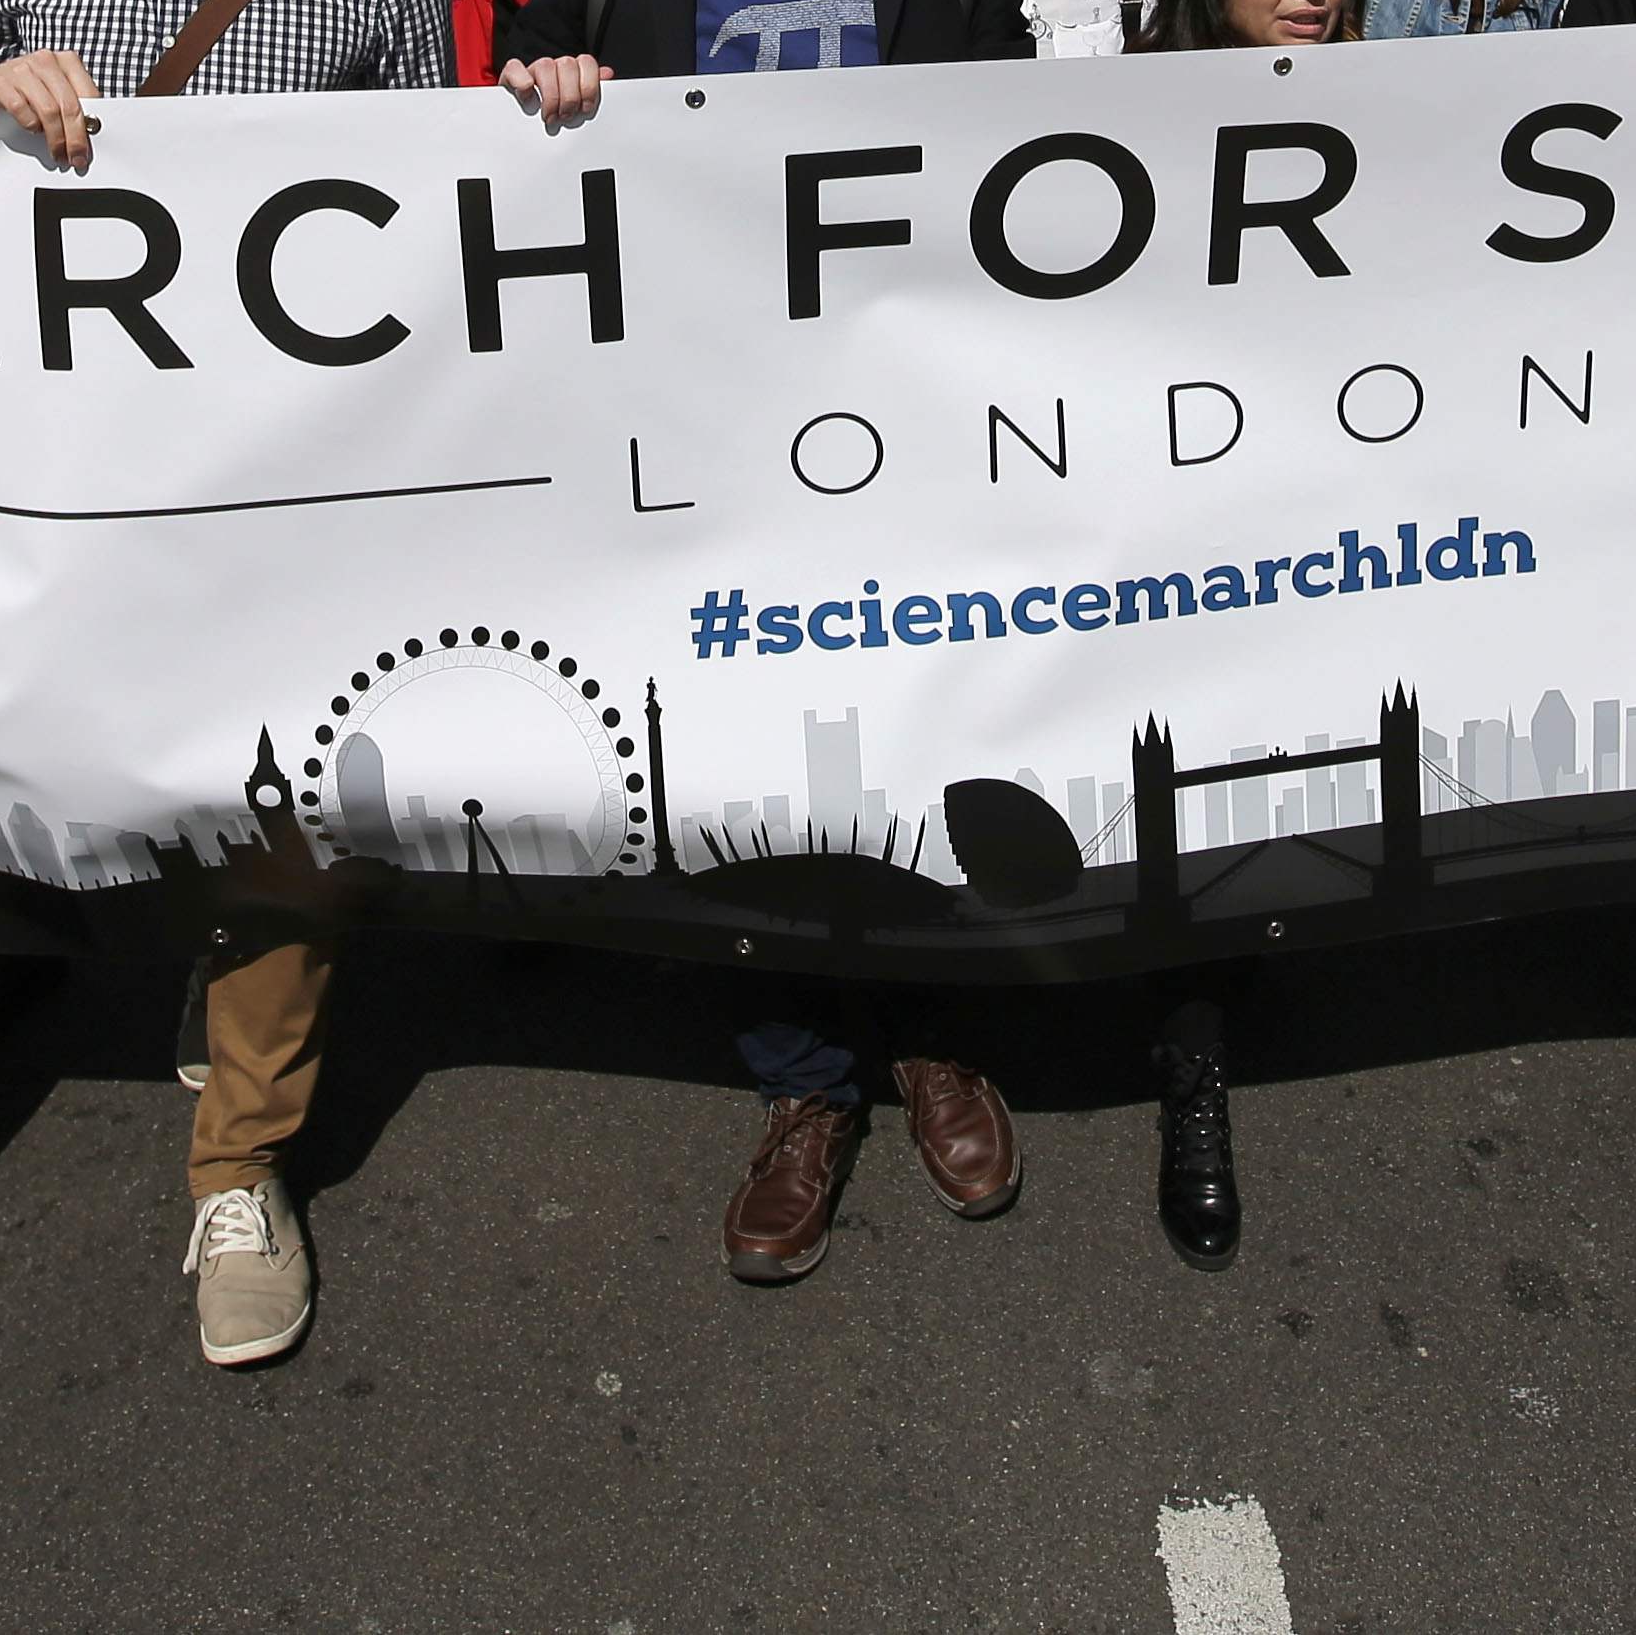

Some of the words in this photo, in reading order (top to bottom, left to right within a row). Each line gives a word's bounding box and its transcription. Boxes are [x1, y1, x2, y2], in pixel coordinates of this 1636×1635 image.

[784, 121, 1358, 321] FOR
[630, 350, 1594, 513] LONDON
[690, 516, 1537, 660] #sciencemarchldn
